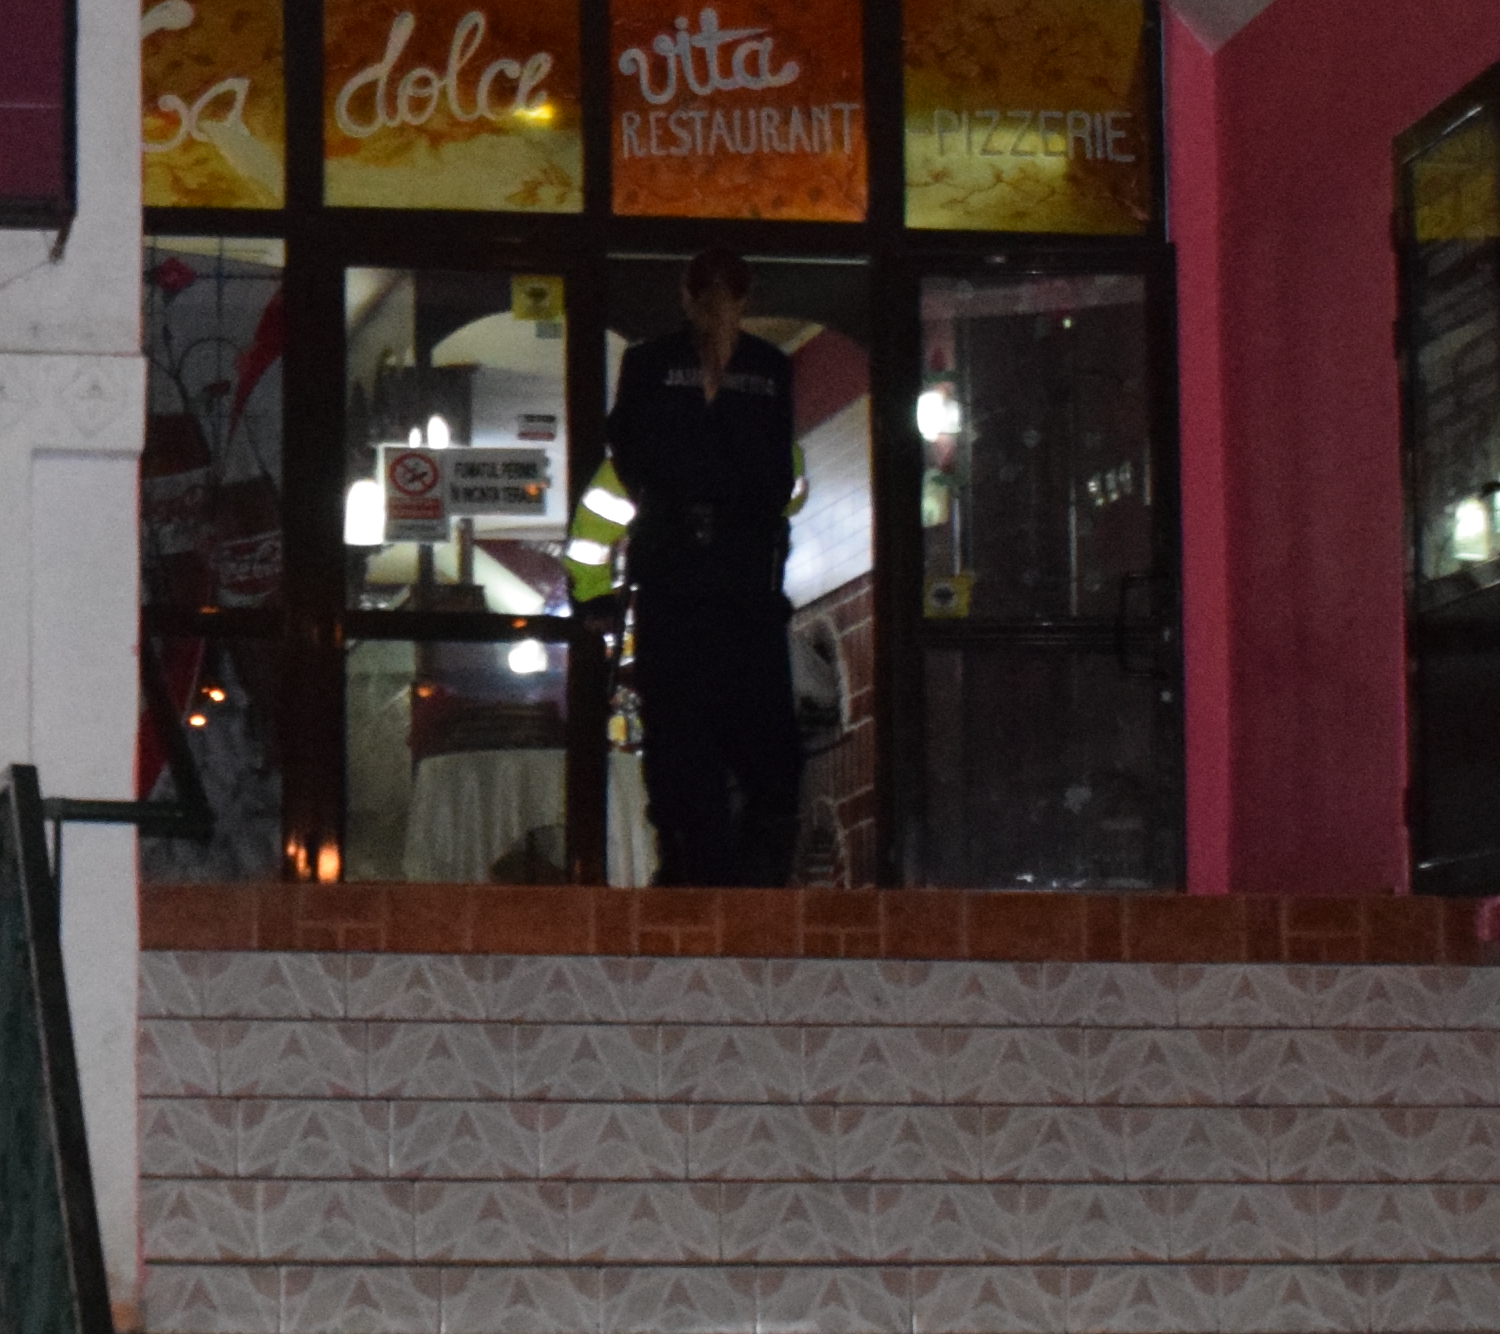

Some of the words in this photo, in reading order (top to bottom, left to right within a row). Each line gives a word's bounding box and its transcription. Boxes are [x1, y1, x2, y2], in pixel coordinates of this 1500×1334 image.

[334, 11, 553, 139] dolce
[618, 5, 800, 107] vita
[622, 100, 862, 158] RESTAURANT
[934, 107, 1138, 163] PIZZERIE
